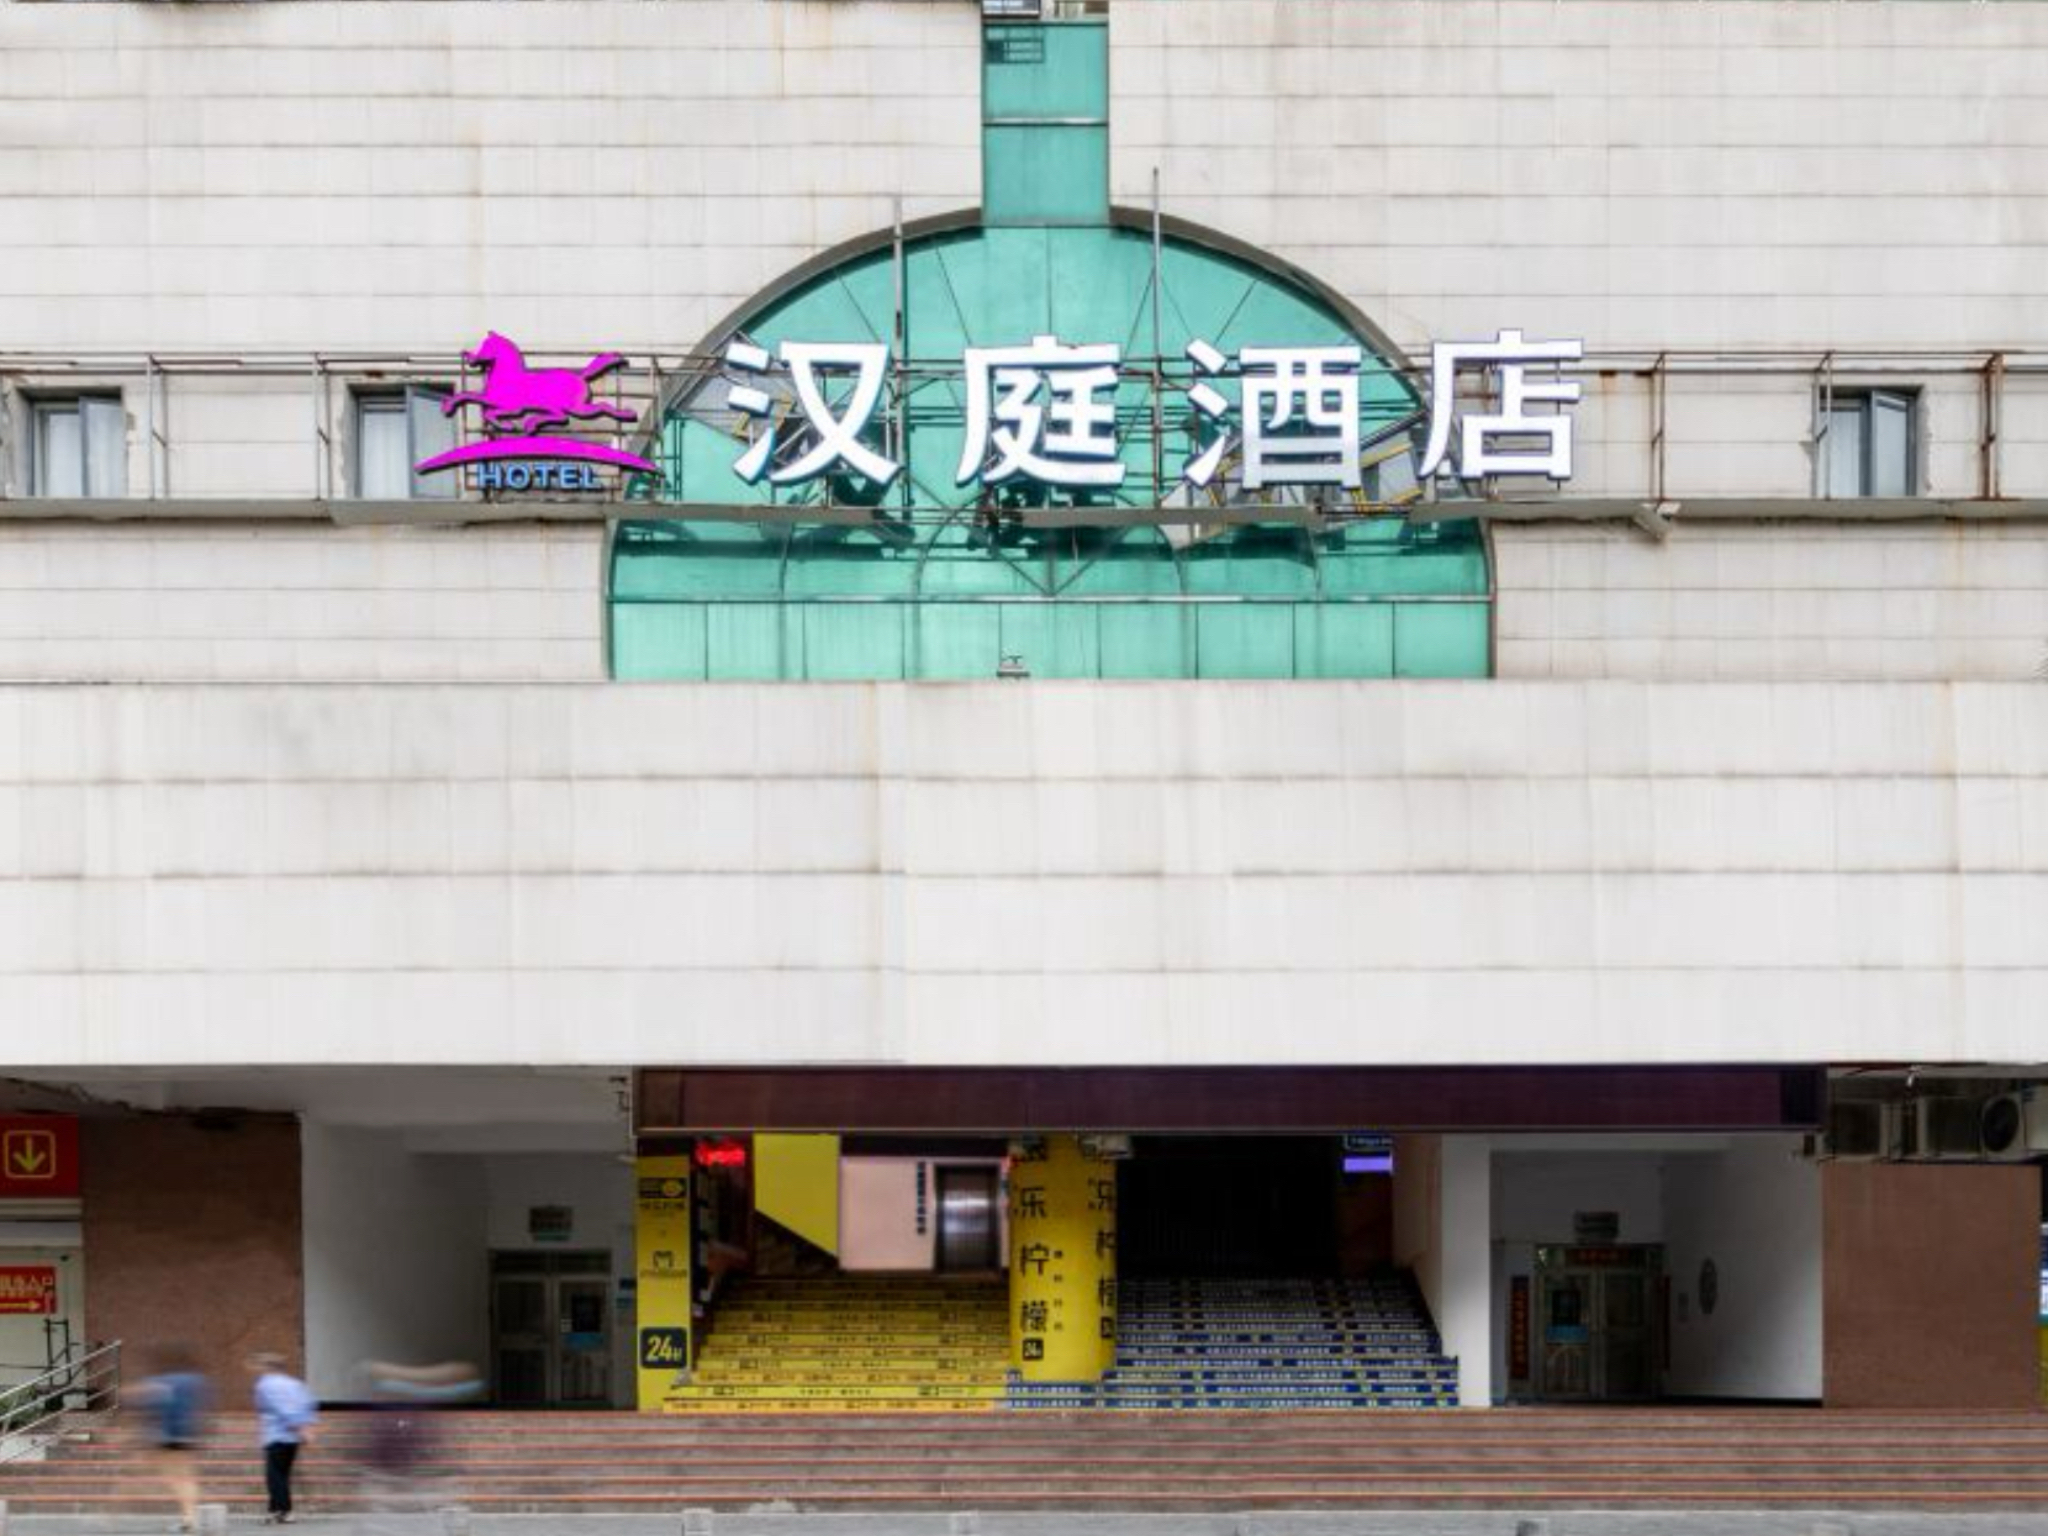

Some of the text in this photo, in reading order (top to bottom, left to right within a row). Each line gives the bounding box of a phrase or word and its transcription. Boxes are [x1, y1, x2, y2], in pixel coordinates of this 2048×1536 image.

[726, 329, 1583, 490] 汉庭酒店
[477, 461, 603, 489] HOTEL
